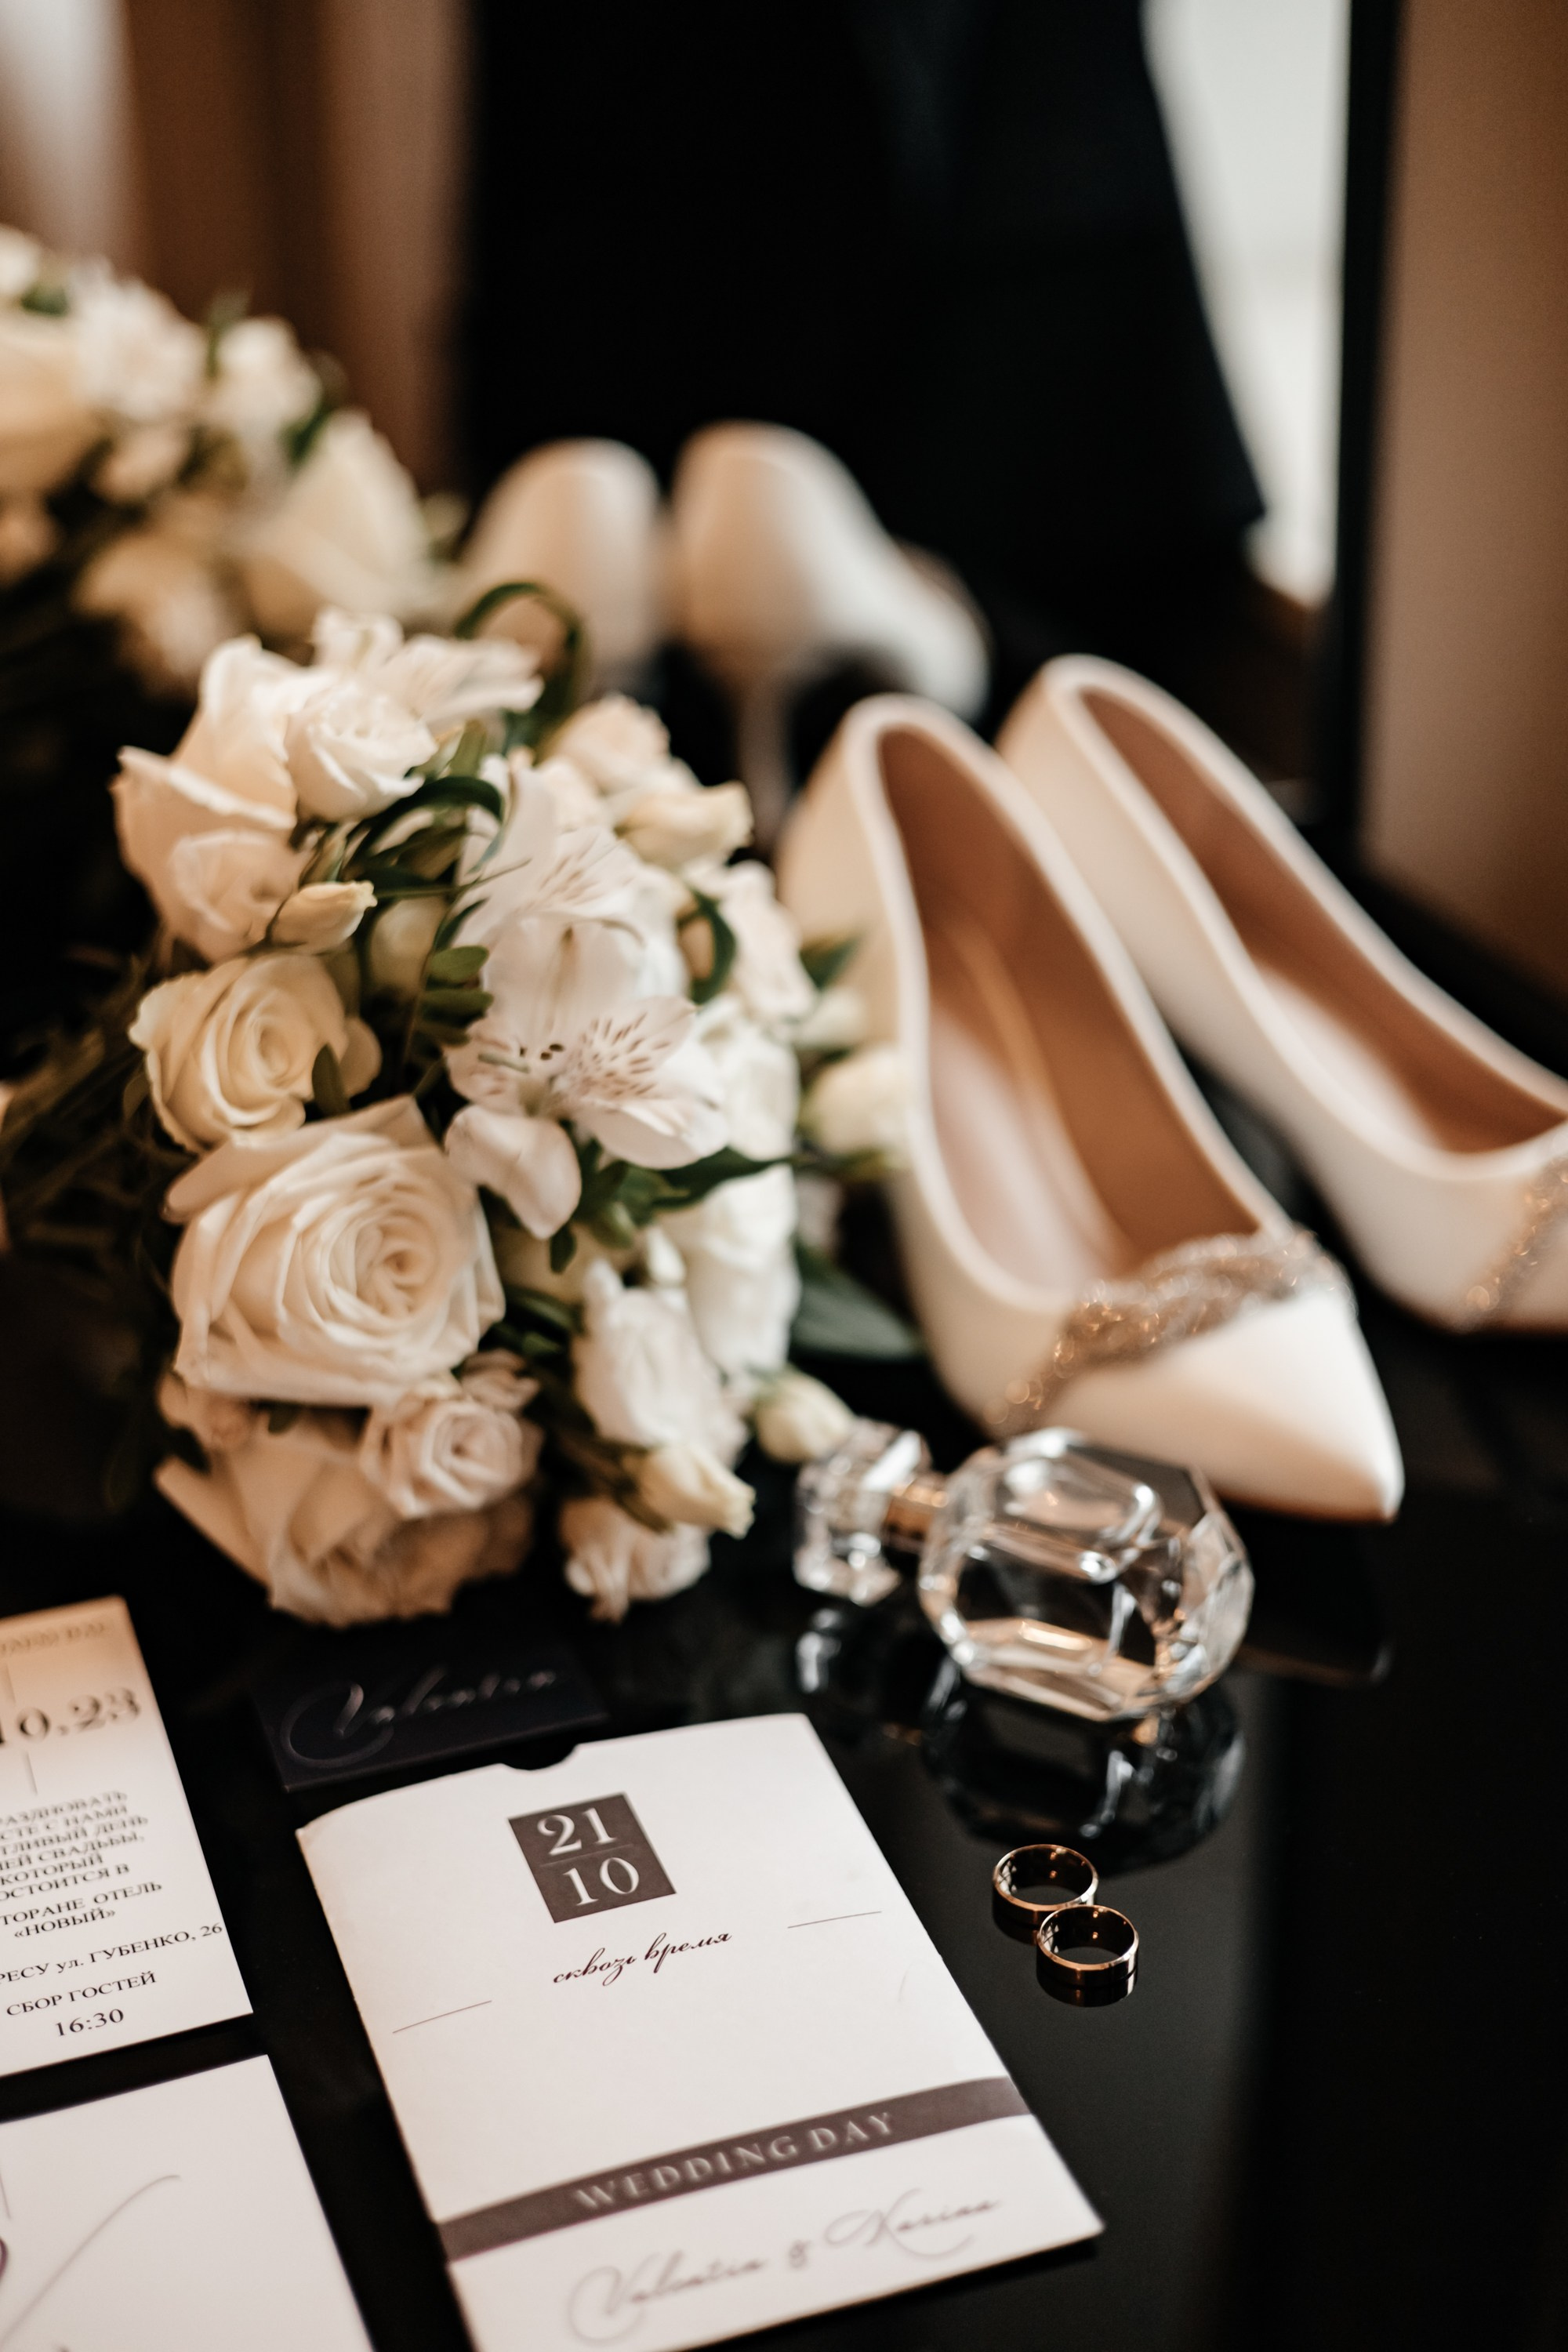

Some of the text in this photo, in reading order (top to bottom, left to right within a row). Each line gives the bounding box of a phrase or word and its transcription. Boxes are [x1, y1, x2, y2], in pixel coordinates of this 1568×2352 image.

[537, 1807, 617, 1856] 21
[93, 1882, 162, 1904] ОТЕЛЬ
[563, 1857, 640, 1907] 10
[56, 1958, 84, 1974] ул.
[200, 1922, 223, 1937] 26
[6, 1970, 158, 2016] СБОР ГОСТЕЙ
[56, 2009, 124, 2037] 16:30
[574, 2111, 894, 2210] WEDDING DAY
